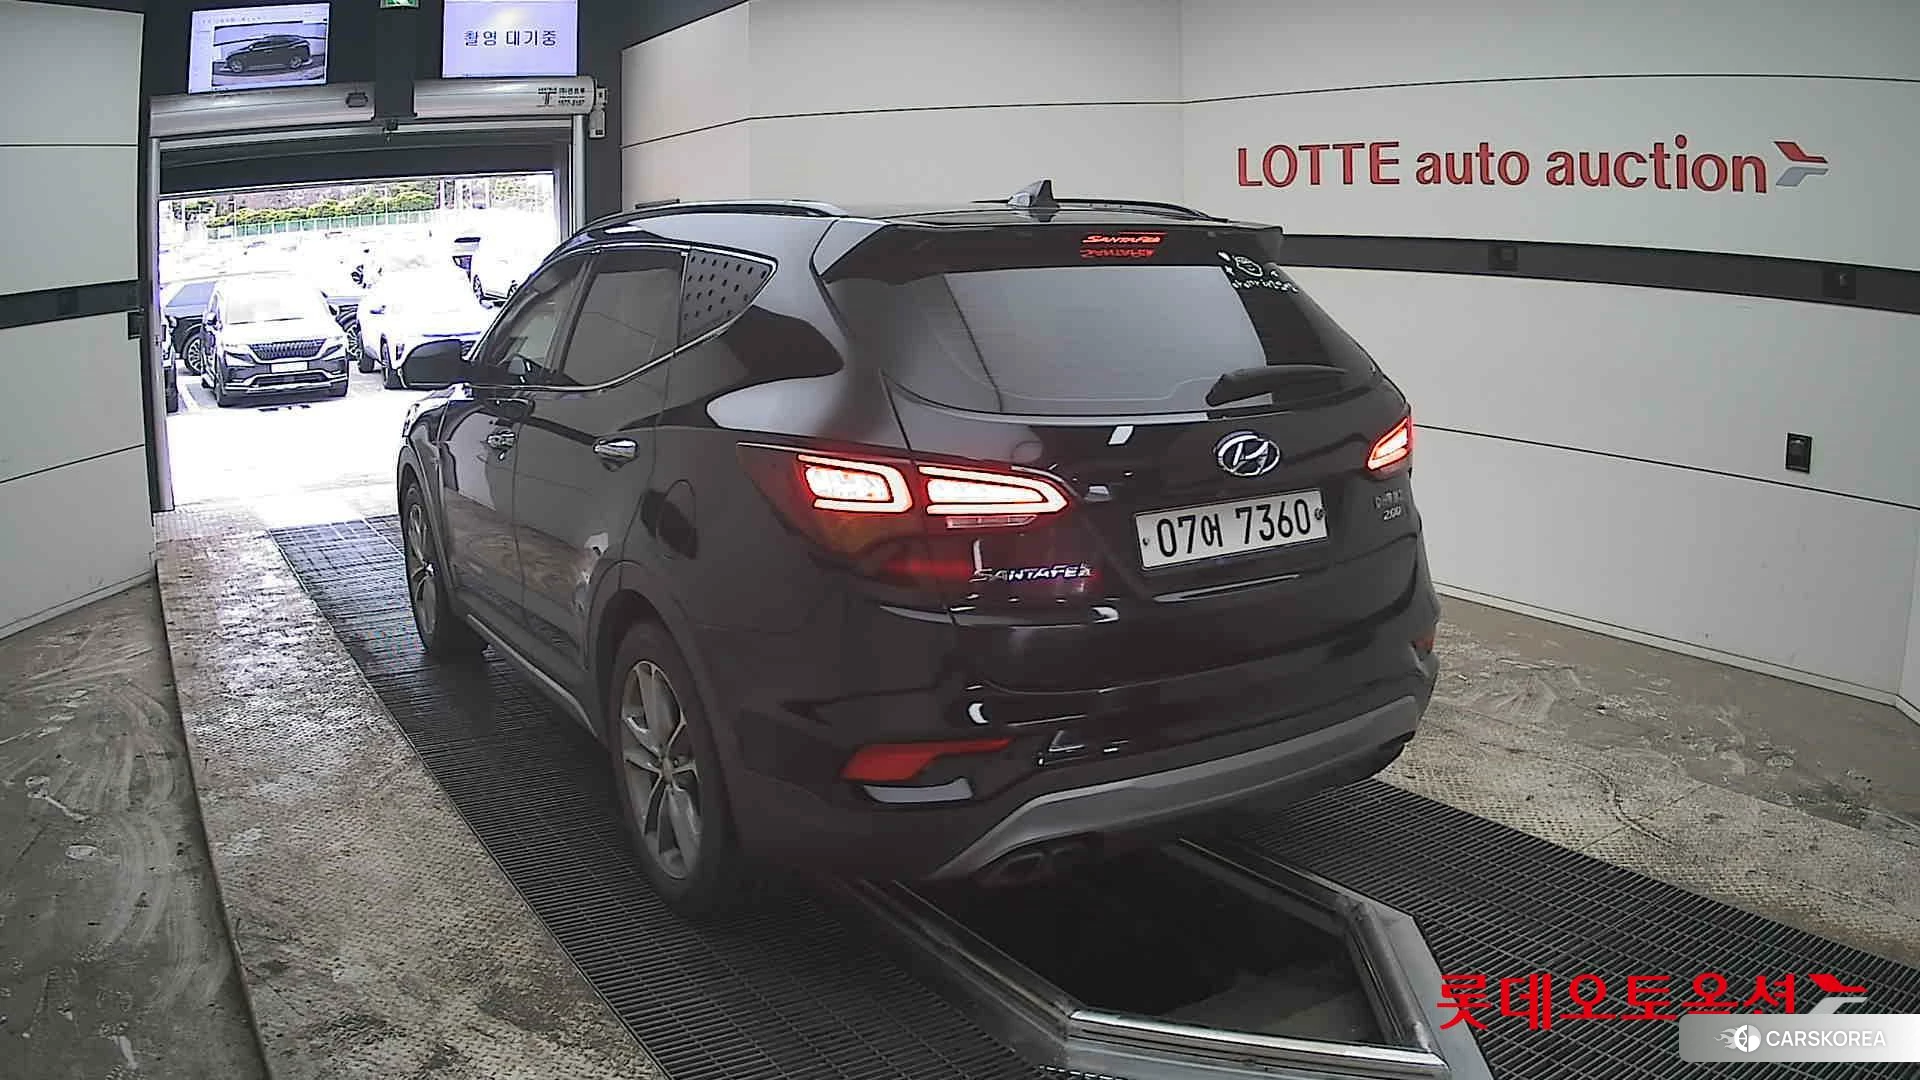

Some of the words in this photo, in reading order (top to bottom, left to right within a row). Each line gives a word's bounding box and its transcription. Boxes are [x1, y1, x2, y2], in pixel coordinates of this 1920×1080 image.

[506, 30, 556, 46] 대기중
[1237, 141, 1401, 188] LOTTE
[1415, 142, 1530, 186] auto
[1546, 135, 1768, 194] auction
[1156, 513, 1224, 558] 07어
[1235, 498, 1312, 546] 7360
